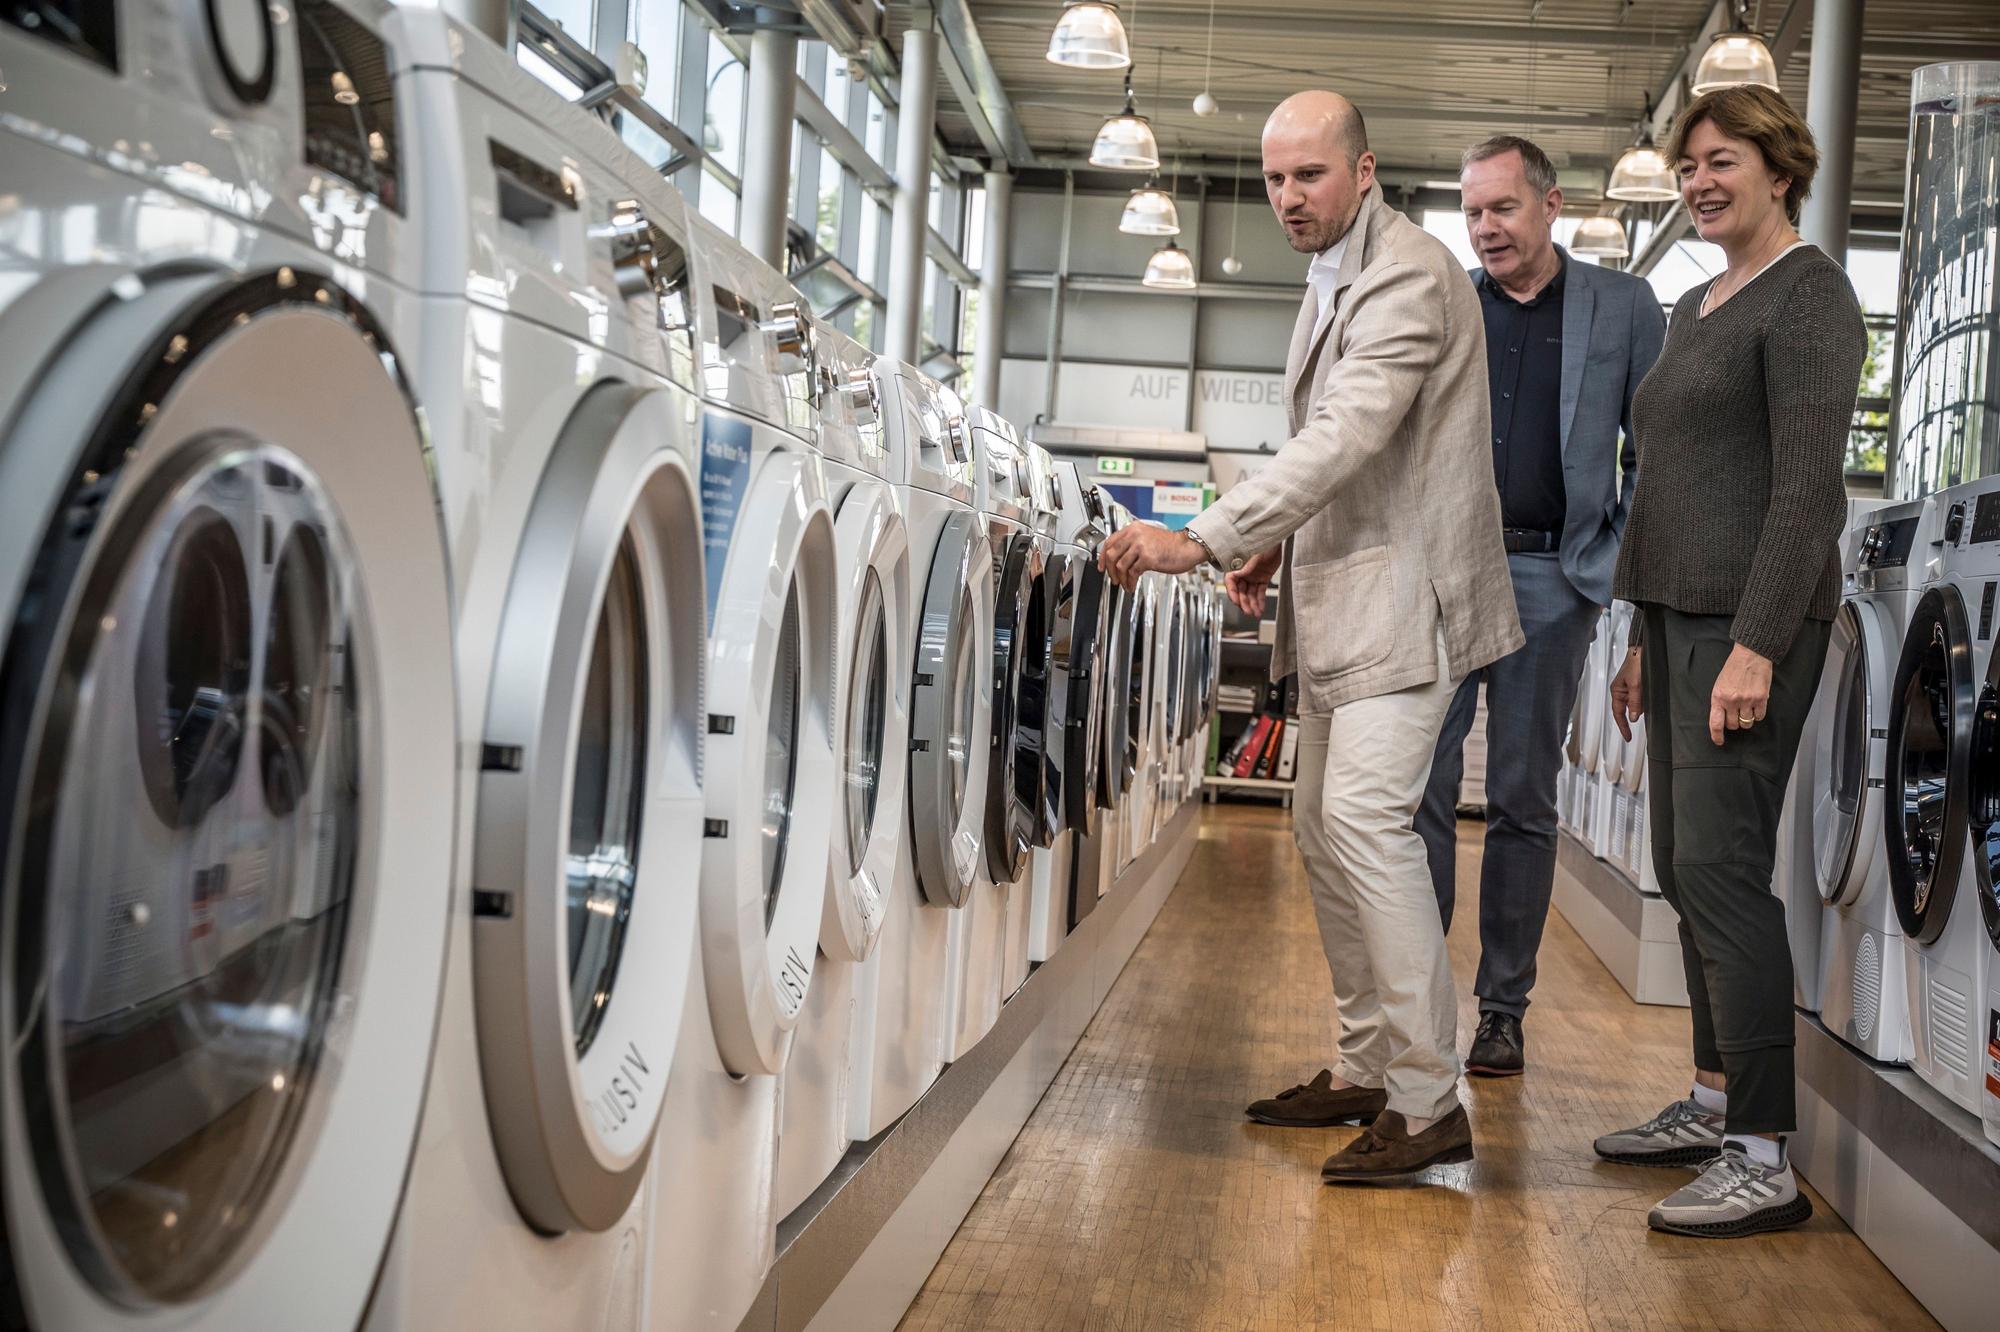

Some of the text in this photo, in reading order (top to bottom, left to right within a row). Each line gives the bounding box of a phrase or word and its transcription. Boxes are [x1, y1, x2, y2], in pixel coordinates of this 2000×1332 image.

[1129, 374, 1286, 406] AUF WIEDE
[1170, 495, 1198, 503] BOSCH
